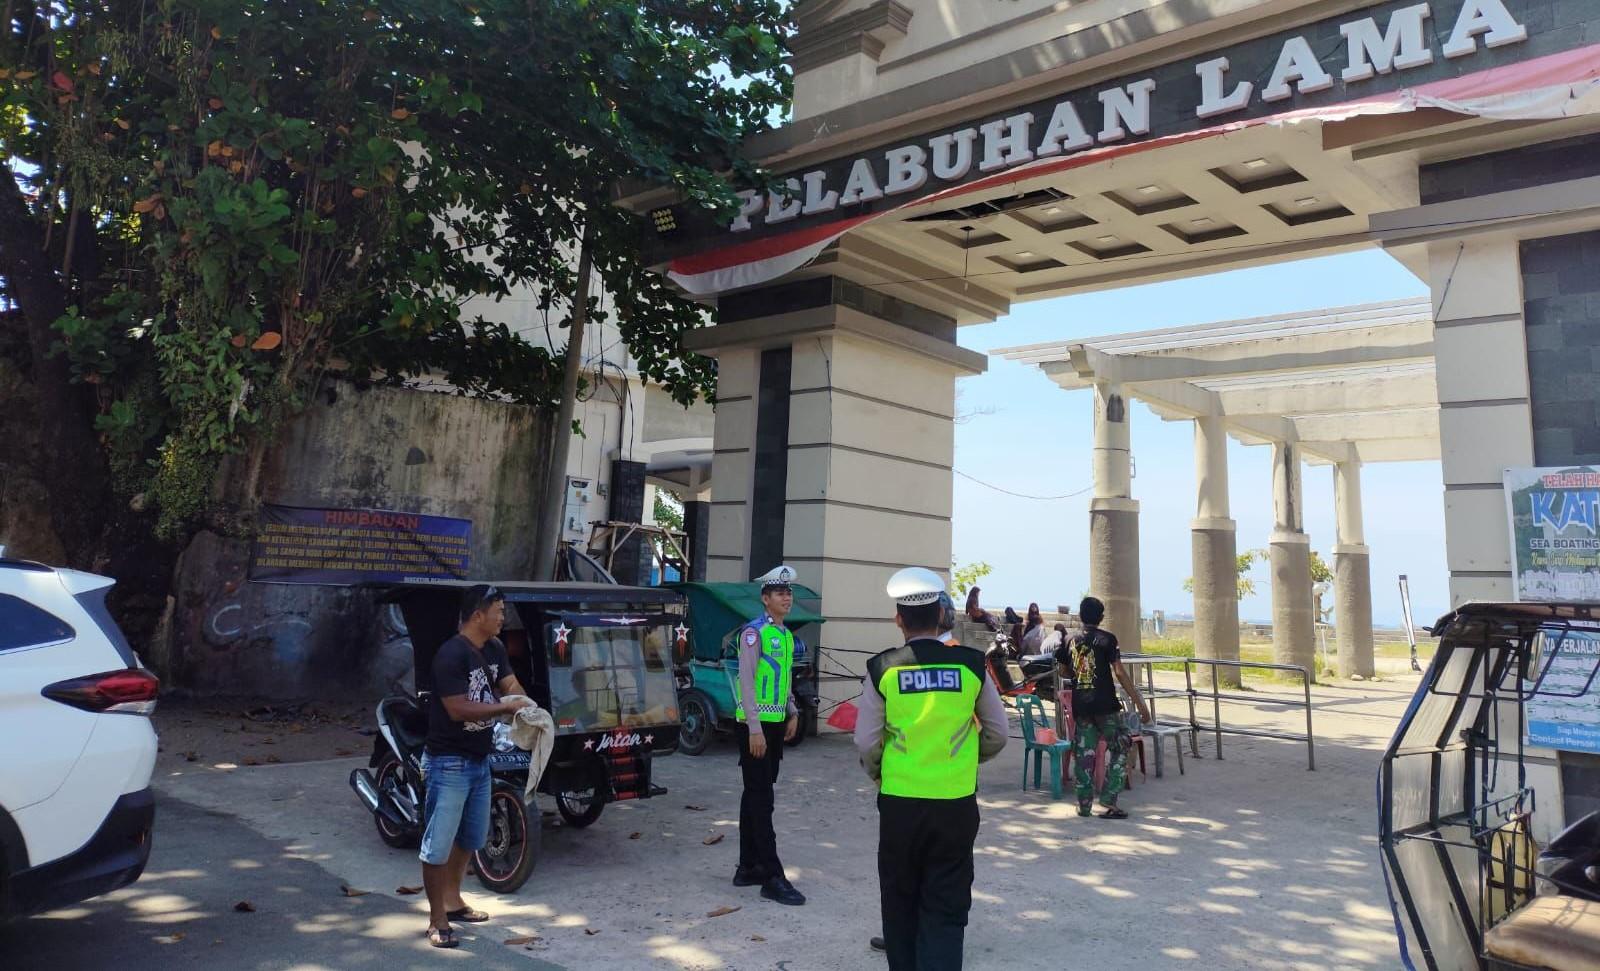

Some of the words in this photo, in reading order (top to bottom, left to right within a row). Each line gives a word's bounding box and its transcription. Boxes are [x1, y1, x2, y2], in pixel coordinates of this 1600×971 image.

[730, 77, 1157, 232] PELABUHAN
[1195, 0, 1527, 118] LAMA
[325, 511, 419, 529] HIMBAUAN
[1530, 538, 1550, 550] SEA
[1553, 537, 1600, 550] BOATING
[900, 669, 960, 690] POLISI
[1531, 734, 1564, 745] Contact
[1565, 737, 1597, 749] Person
